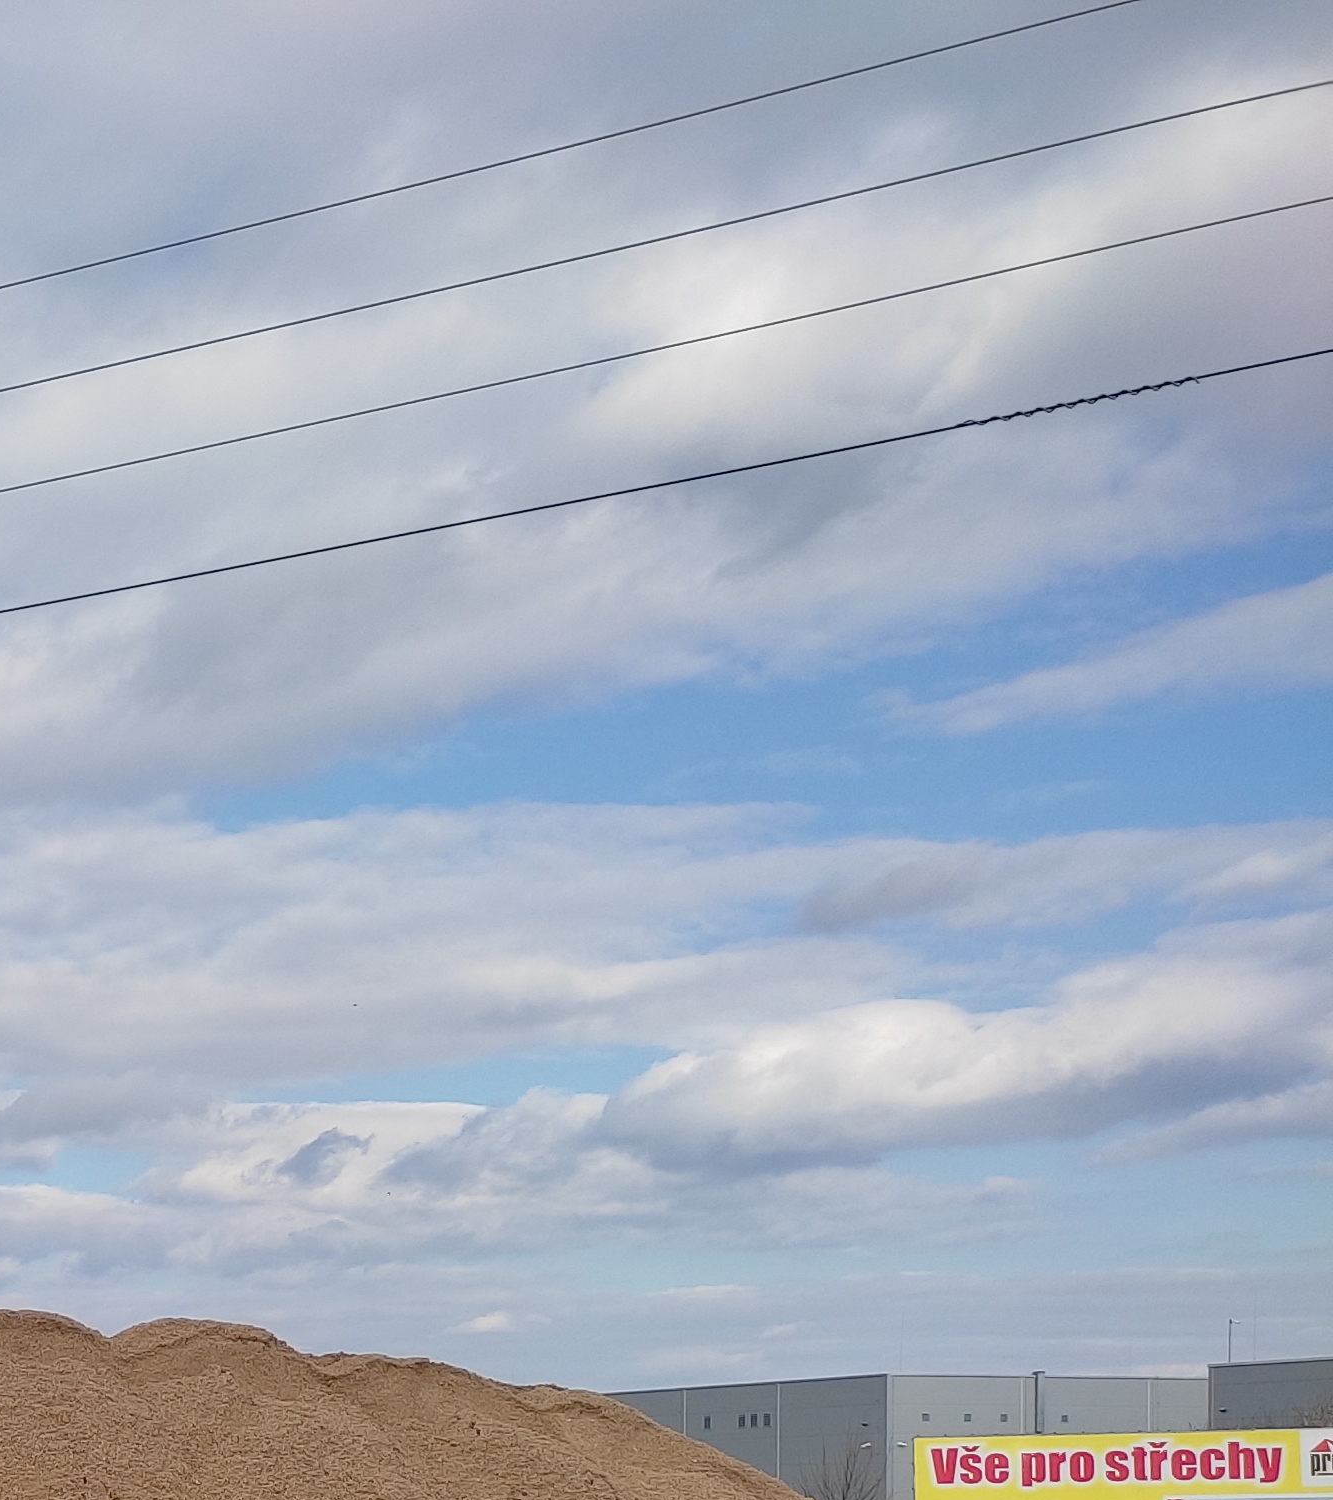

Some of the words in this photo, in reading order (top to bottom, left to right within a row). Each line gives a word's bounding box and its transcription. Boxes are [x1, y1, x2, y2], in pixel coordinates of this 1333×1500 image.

[931, 1445, 1010, 1485] Vše
[1021, 1451, 1095, 1487] pro
[1105, 1441, 1283, 1483] střechy
